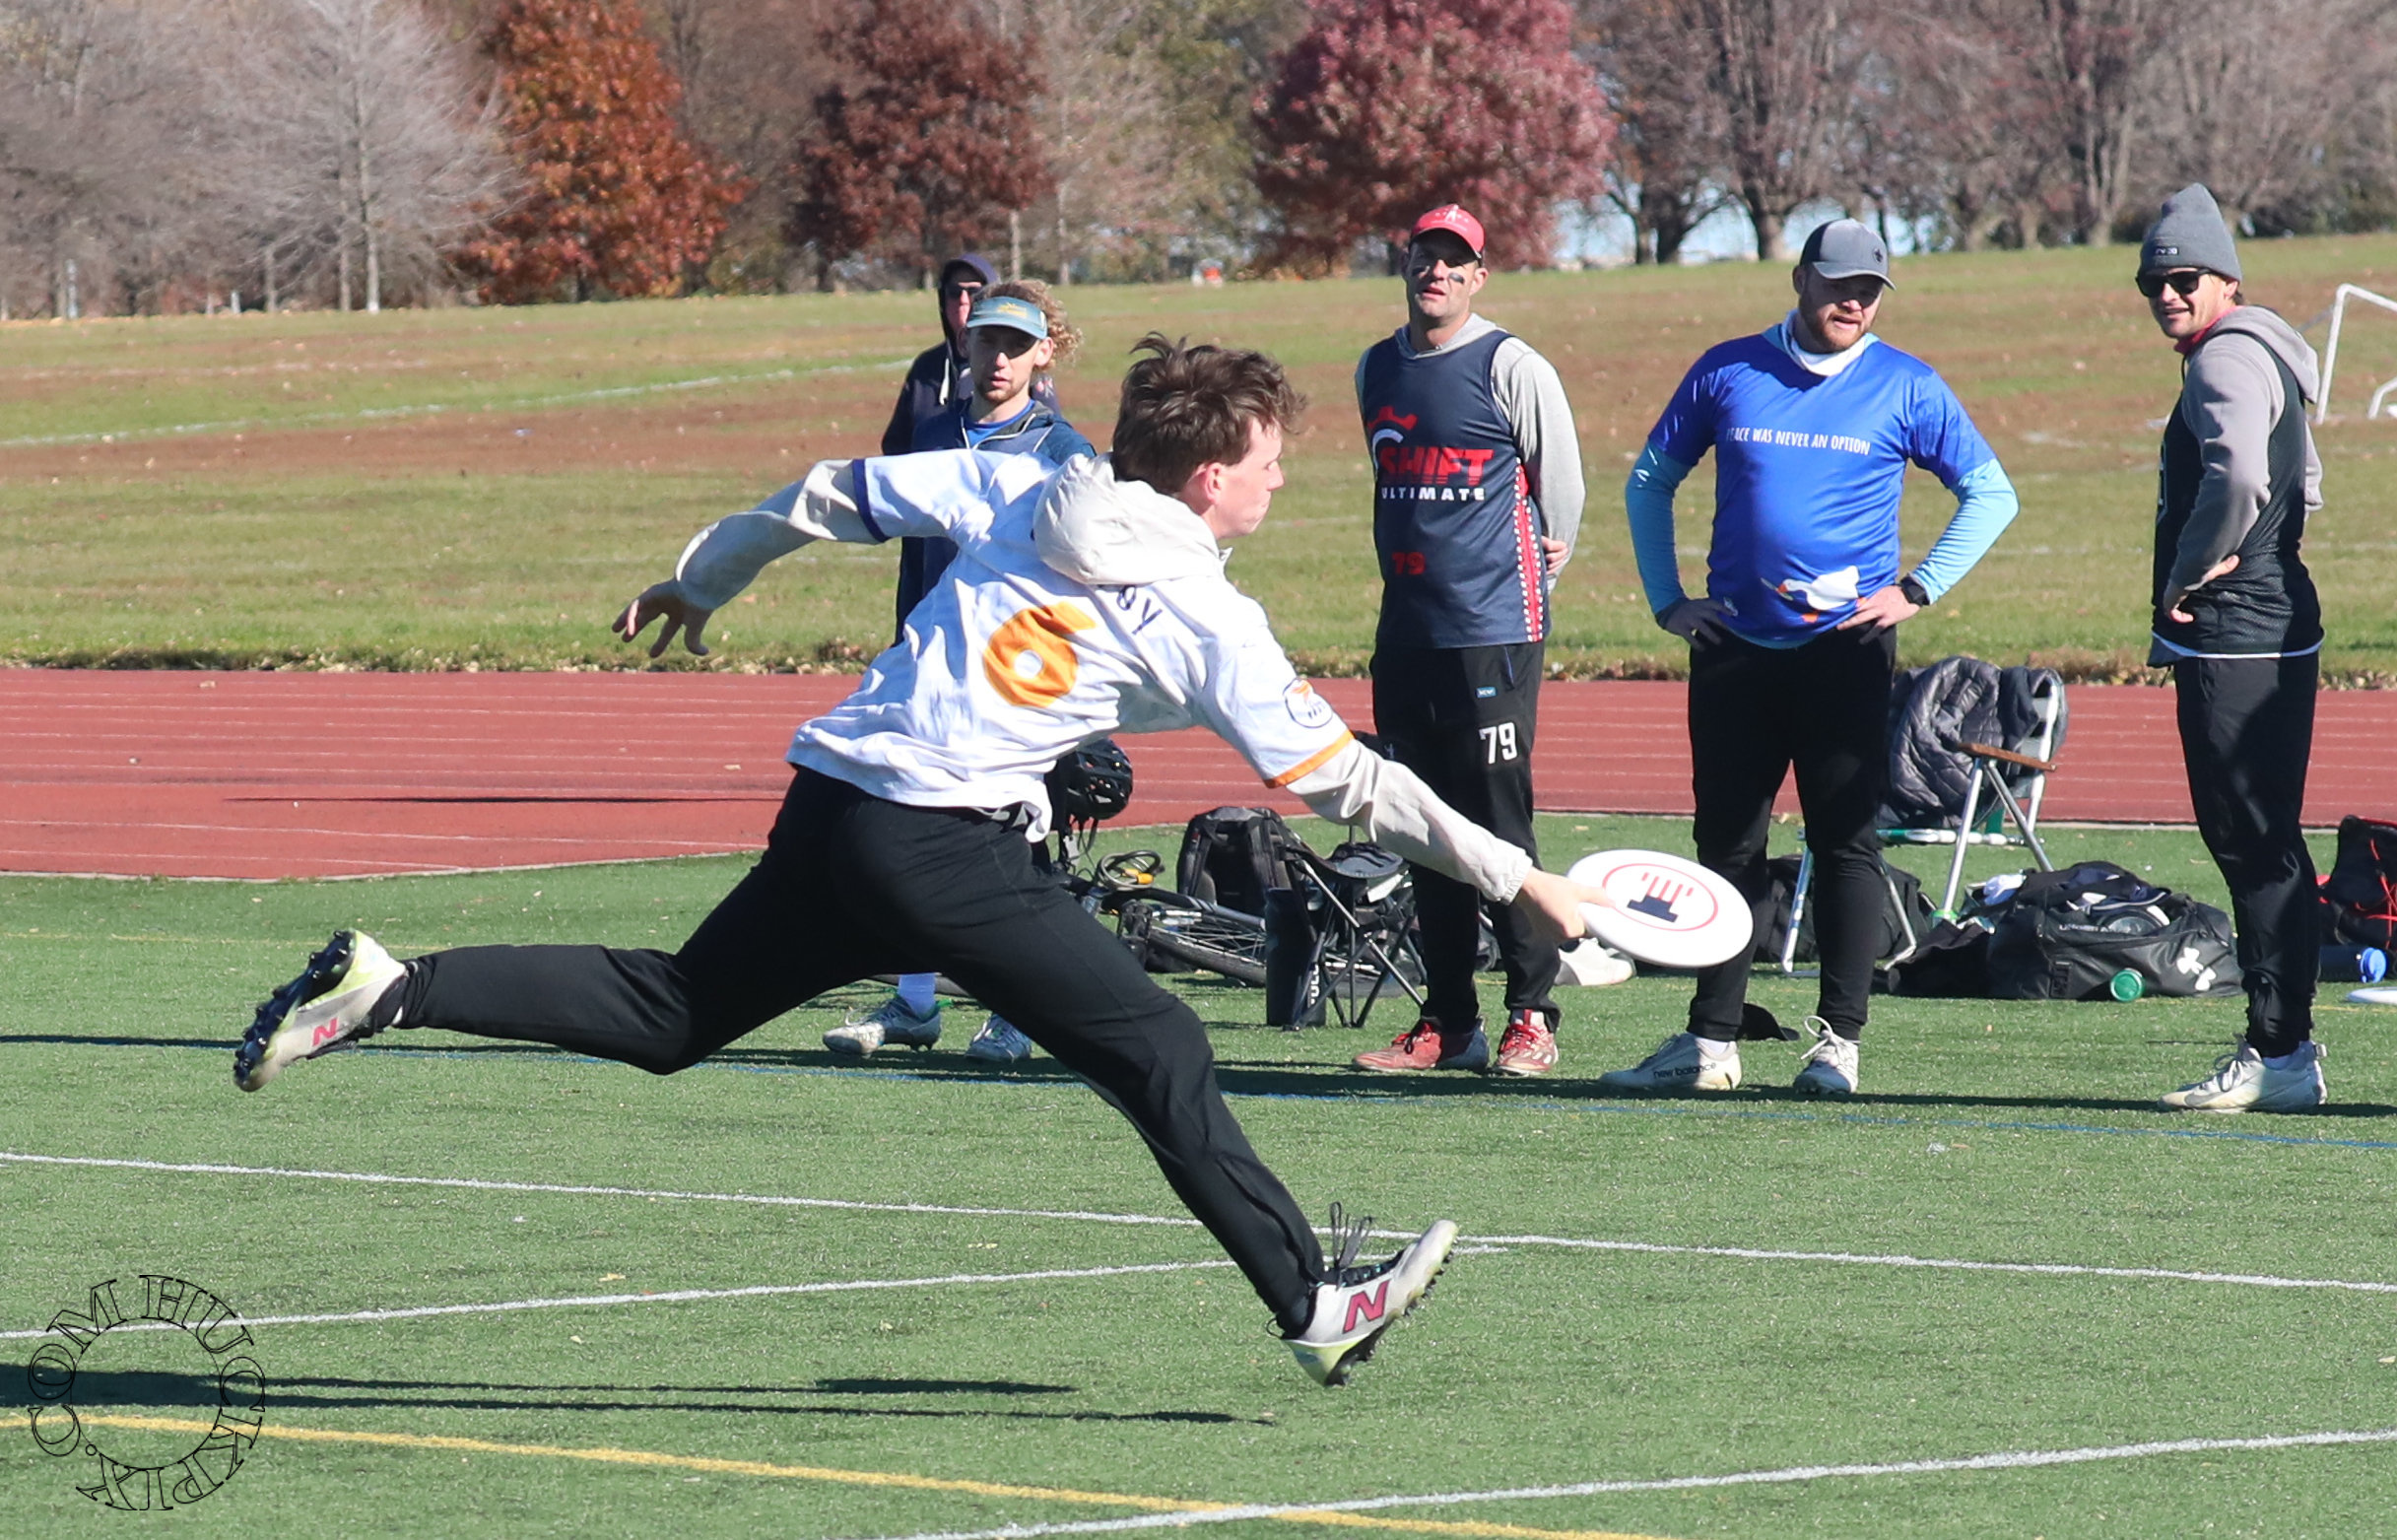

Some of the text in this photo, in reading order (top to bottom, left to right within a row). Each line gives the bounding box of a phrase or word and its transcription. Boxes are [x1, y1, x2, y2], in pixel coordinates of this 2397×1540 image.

[1726, 427, 1871, 456] PEACE WAS NEVER AN OPTION
[1380, 445, 1495, 486] SHIFT
[1381, 487, 1486, 502] ULTIMATE
[1391, 551, 1427, 575] 79
[982, 601, 1097, 707] 6
[1478, 721, 1517, 765] 79
[1653, 1062, 1716, 1080] new balance
[1342, 1279, 1391, 1334] N
